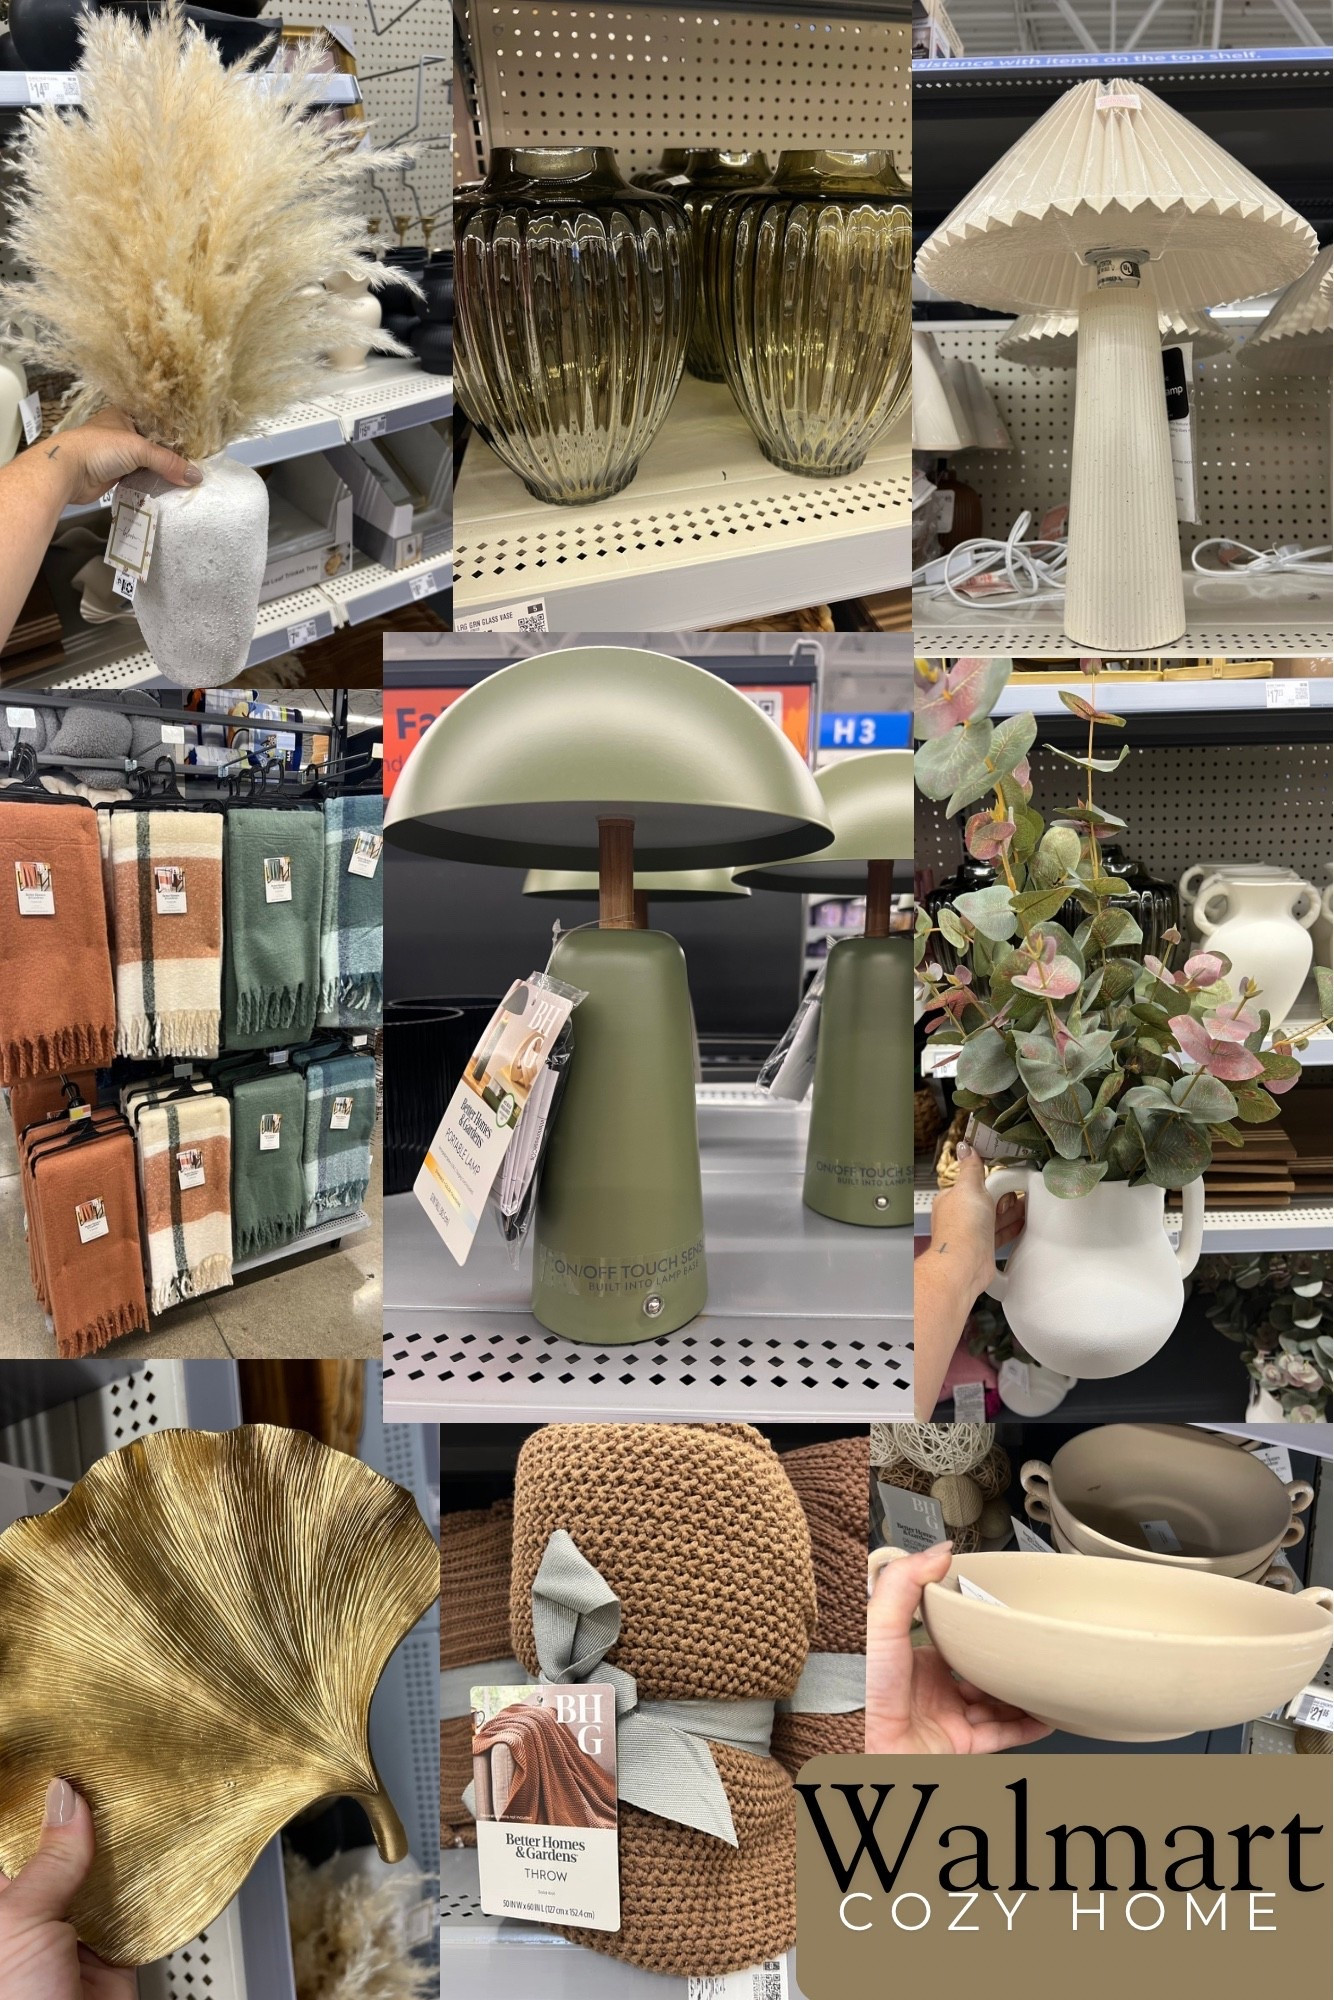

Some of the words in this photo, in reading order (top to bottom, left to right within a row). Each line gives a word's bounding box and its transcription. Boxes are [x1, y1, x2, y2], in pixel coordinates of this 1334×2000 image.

[1000, 58, 1040, 66] with
[1046, 56, 1099, 65] items
[1104, 55, 1128, 63] on
[1133, 54, 1166, 63] the
[1171, 54, 1204, 63] top
[1209, 51, 1261, 61] shelf.
[482, 616, 499, 626] GLASS
[500, 612, 514, 621] VASE
[396, 706, 449, 740] Fa
[460, 1097, 477, 1122] Better
[473, 1111, 493, 1139] Homes
[445, 1127, 468, 1161] PORTABLE
[464, 1151, 481, 1176] LAMP
[815, 1160, 857, 1178] ON/OFF
[860, 1166, 903, 1179] TOUCH
[837, 1177, 859, 1186] BUILT
[862, 1179, 884, 1187] INTO
[885, 1178, 906, 1187] LAMP
[554, 1259, 617, 1280] ON/OFF
[621, 1255, 678, 1279] TOUCH
[588, 1281, 620, 1292] BUILT
[625, 1278, 653, 1291] INTO
[656, 1269, 682, 1286] LAMP
[683, 1260, 700, 1276] BASE
[915, 1527, 937, 1540] Homes
[505, 1833, 541, 1848] Better
[542, 1835, 586, 1852] Homes
[524, 1867, 568, 1883] THROW
[503, 1899, 510, 1908] 50
[527, 1903, 534, 1911] 60
[545, 1905, 556, 1915] (127
[569, 1908, 583, 1917] 152.4
